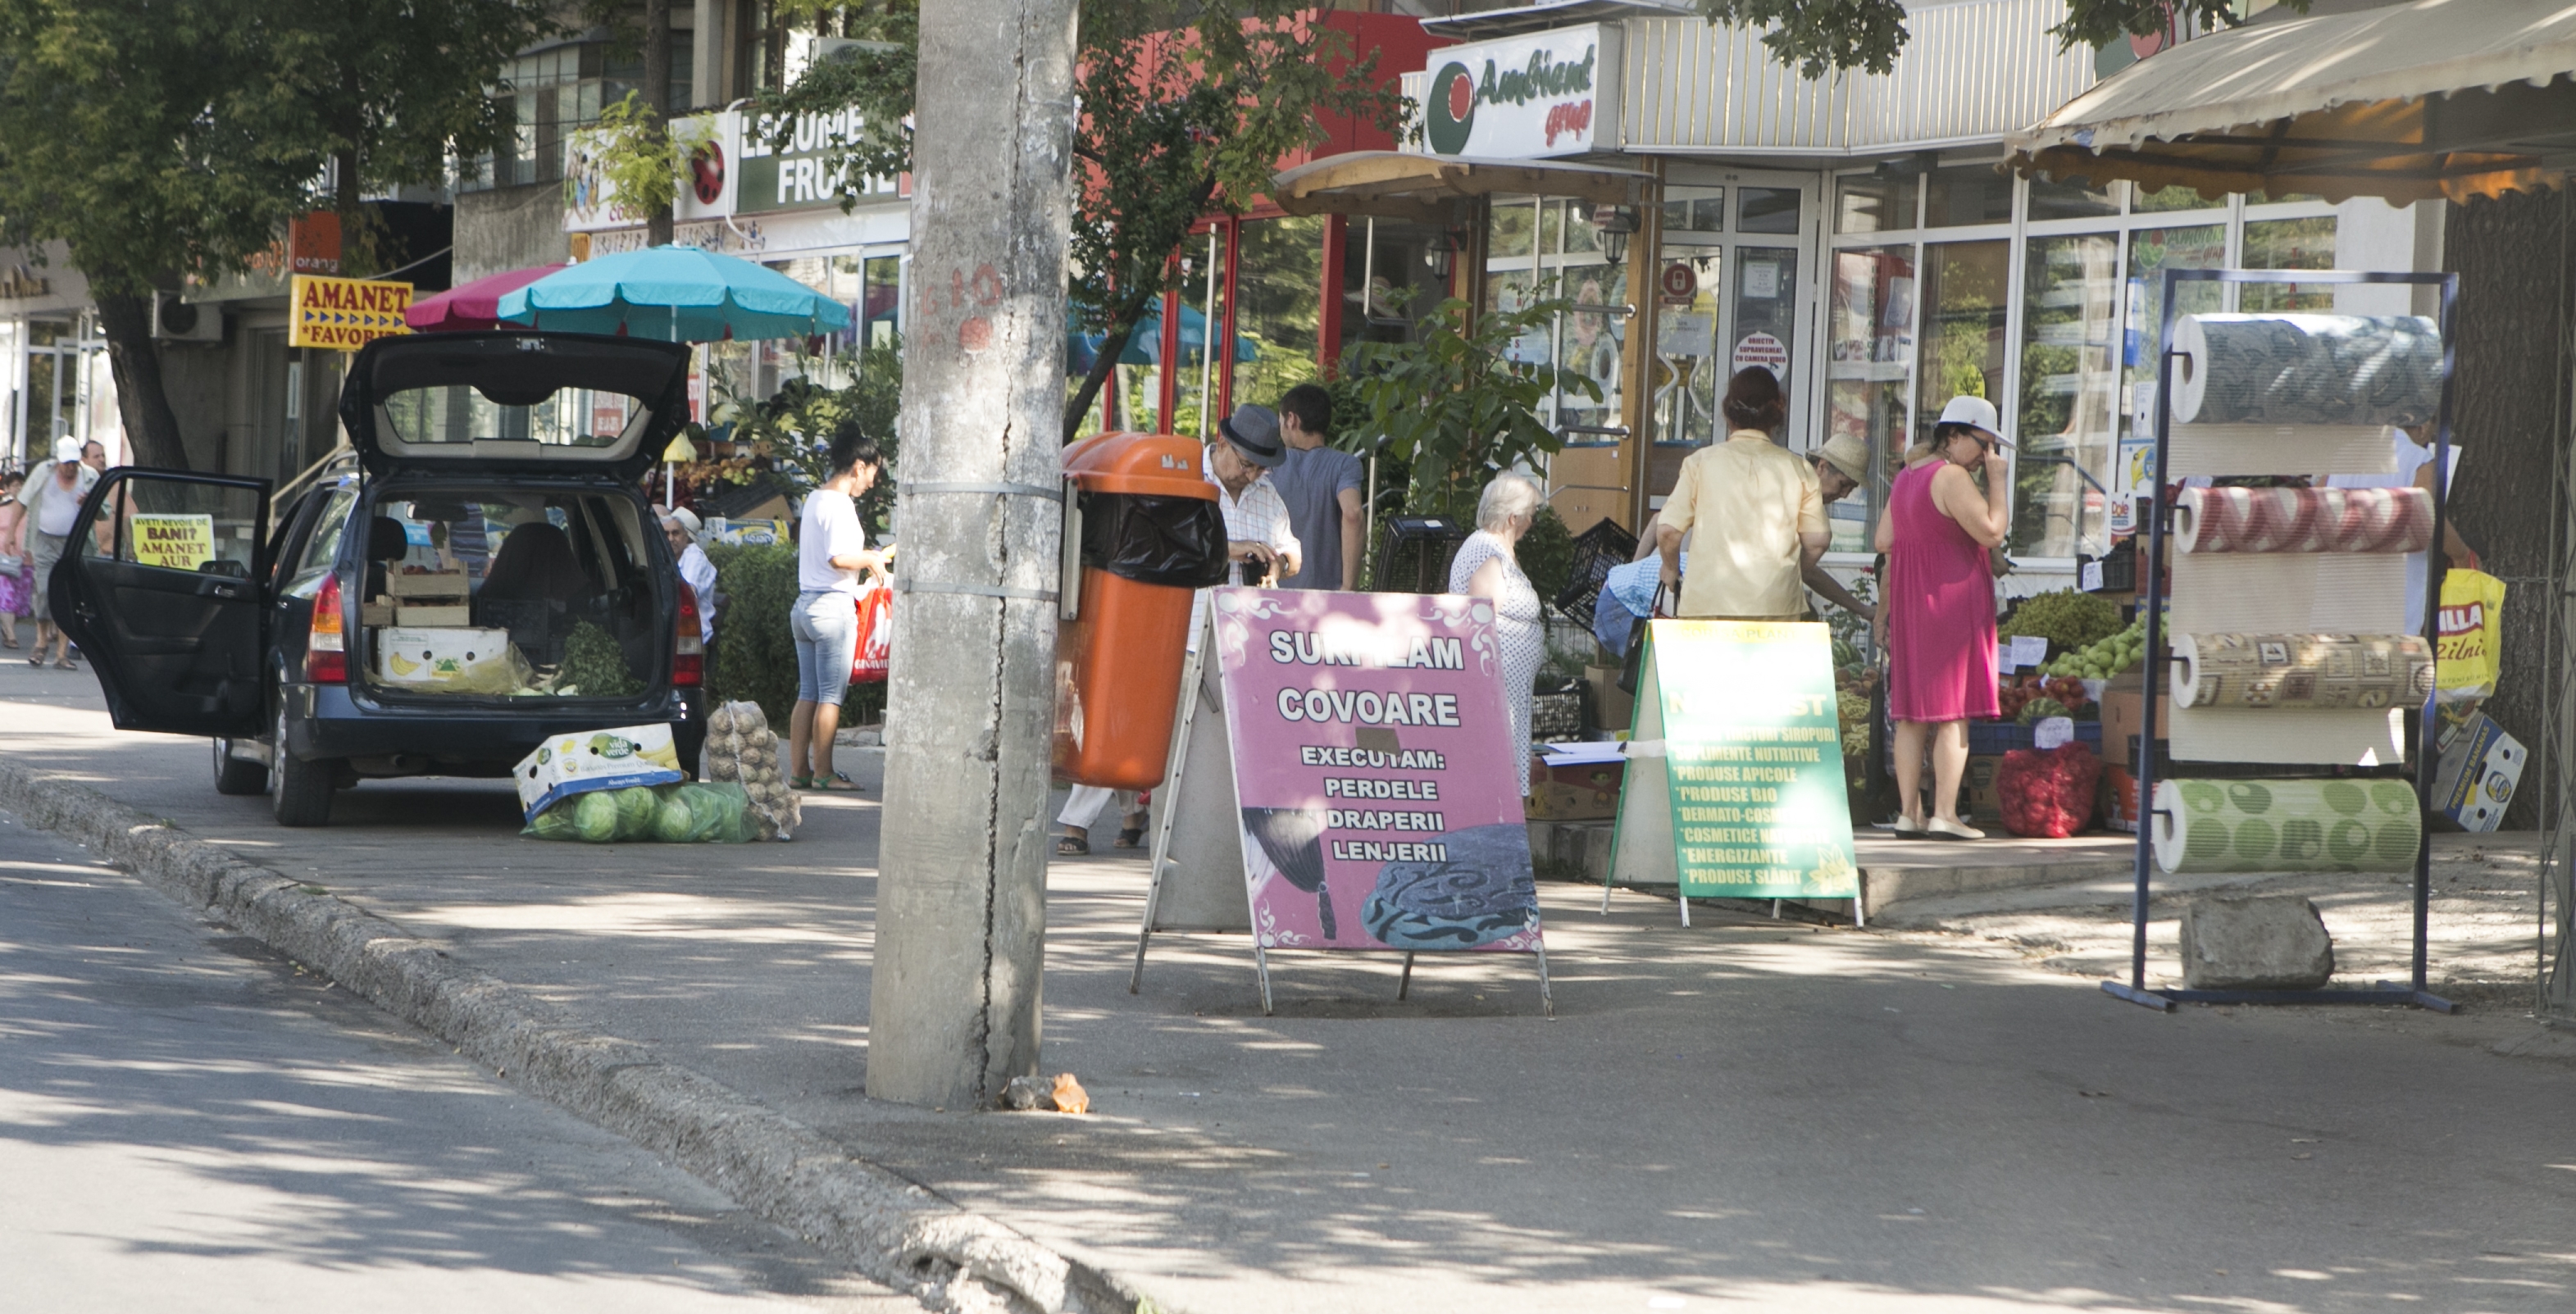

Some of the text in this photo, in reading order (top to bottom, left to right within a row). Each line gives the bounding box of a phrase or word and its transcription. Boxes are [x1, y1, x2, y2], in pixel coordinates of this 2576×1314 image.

[1475, 43, 1595, 106] Ambient
[296, 256, 339, 273] orang
[303, 280, 409, 313] AMANET
[1769, 355, 1786, 363] VIDEO
[2112, 501, 2129, 516] Dole
[147, 527, 197, 540] BANI?
[140, 543, 207, 554] AMANET
[160, 556, 193, 566] AUR
[2438, 604, 2483, 632] ILLA
[1745, 629, 1797, 639] PLANT
[1277, 686, 1462, 727] COVOARE
[608, 738, 628, 748] vida
[606, 747, 630, 757] verde
[1300, 744, 1447, 770] EXECUTAM:
[1754, 747, 1821, 762] NUTRITIVE
[607, 760, 636, 770] Premium
[2450, 725, 2490, 810] PREMIUM BANANAS
[1742, 767, 1798, 783] APICOLE
[1323, 776, 1440, 801] PERDELE
[1750, 787, 1777, 802] BIO
[1326, 809, 1445, 831] DRAPERII
[1331, 839, 1448, 863] LENJERII
